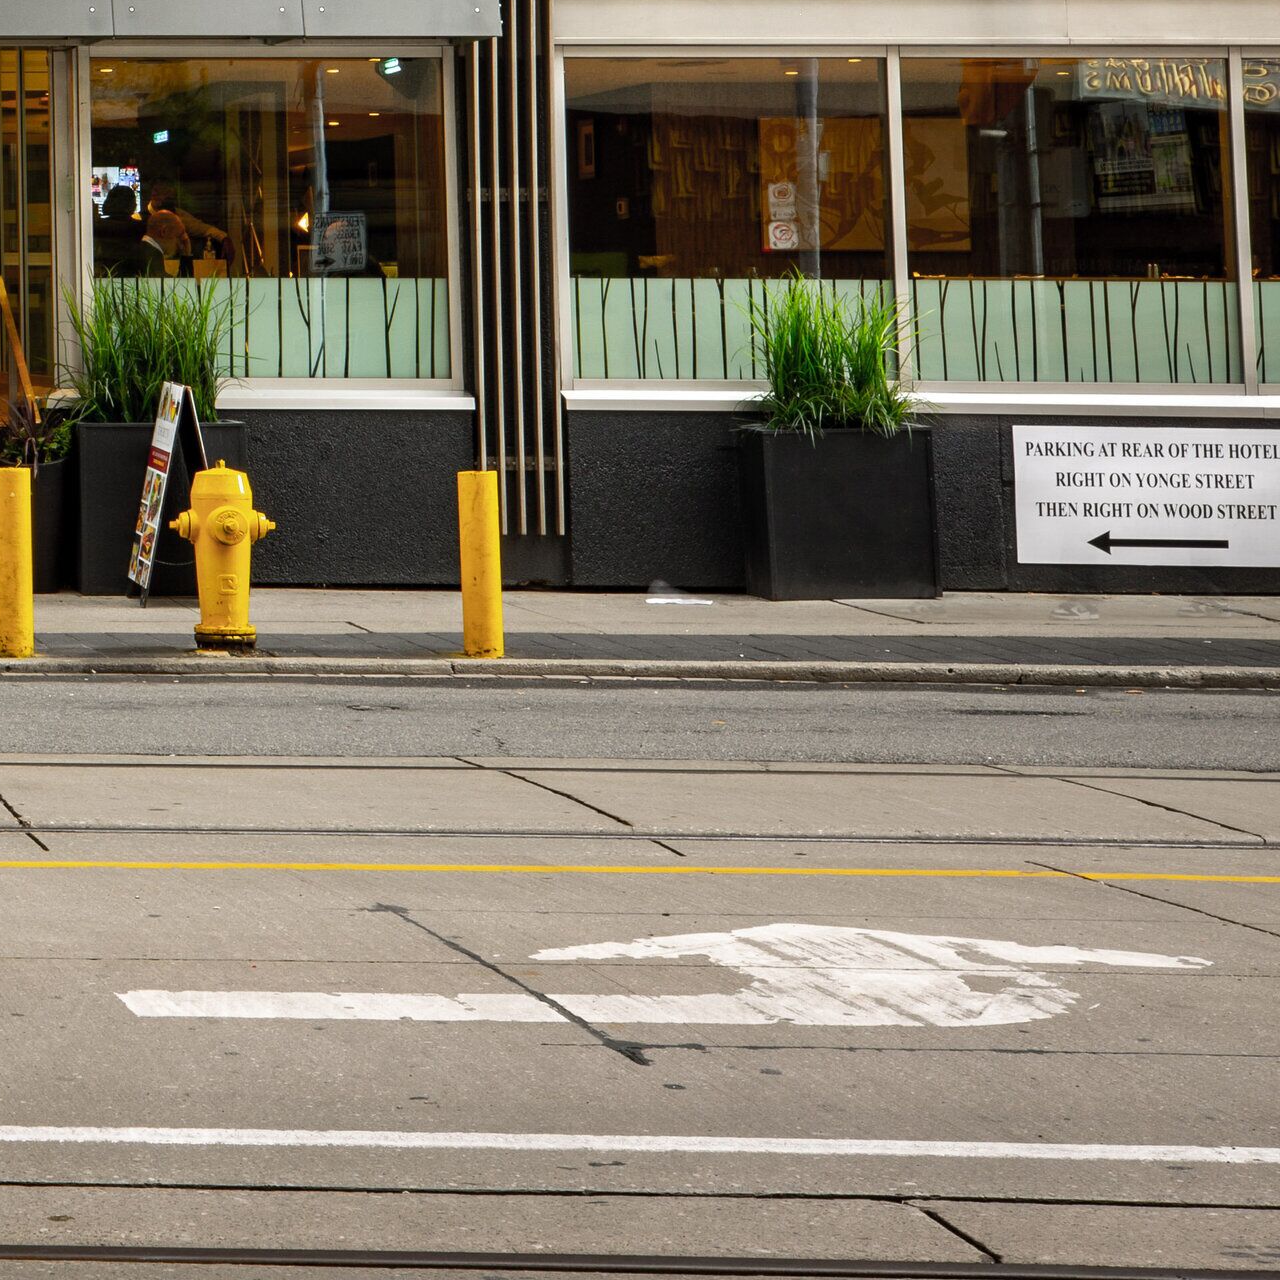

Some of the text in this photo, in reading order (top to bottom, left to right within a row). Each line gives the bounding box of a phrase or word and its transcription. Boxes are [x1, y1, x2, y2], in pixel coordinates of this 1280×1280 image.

[1025, 440, 1280, 460] PARKING AT REAR OF THE HOTEL
[1055, 471, 1256, 490] RIGHT ON YONGE STREET
[1035, 501, 1279, 520] THEN RIGHT ON WOOD STREET
